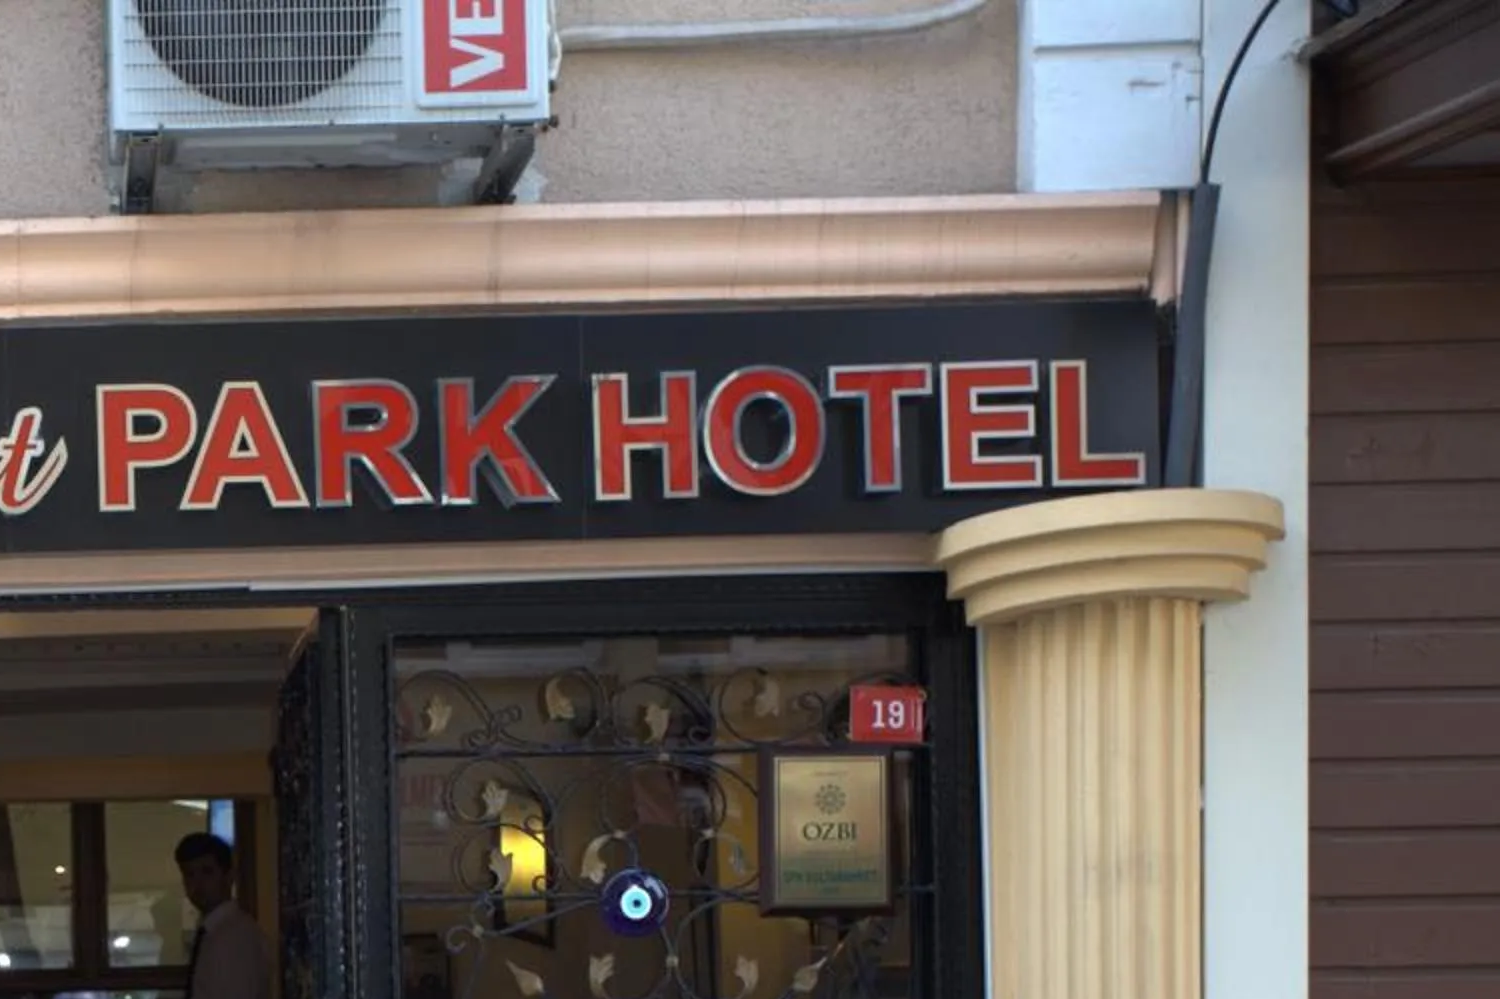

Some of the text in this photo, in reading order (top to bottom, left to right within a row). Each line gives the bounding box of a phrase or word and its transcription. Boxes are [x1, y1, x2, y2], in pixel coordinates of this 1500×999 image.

[96, 374, 561, 511] PARK
[592, 359, 1146, 500] HOTEL
[871, 700, 905, 728] 19
